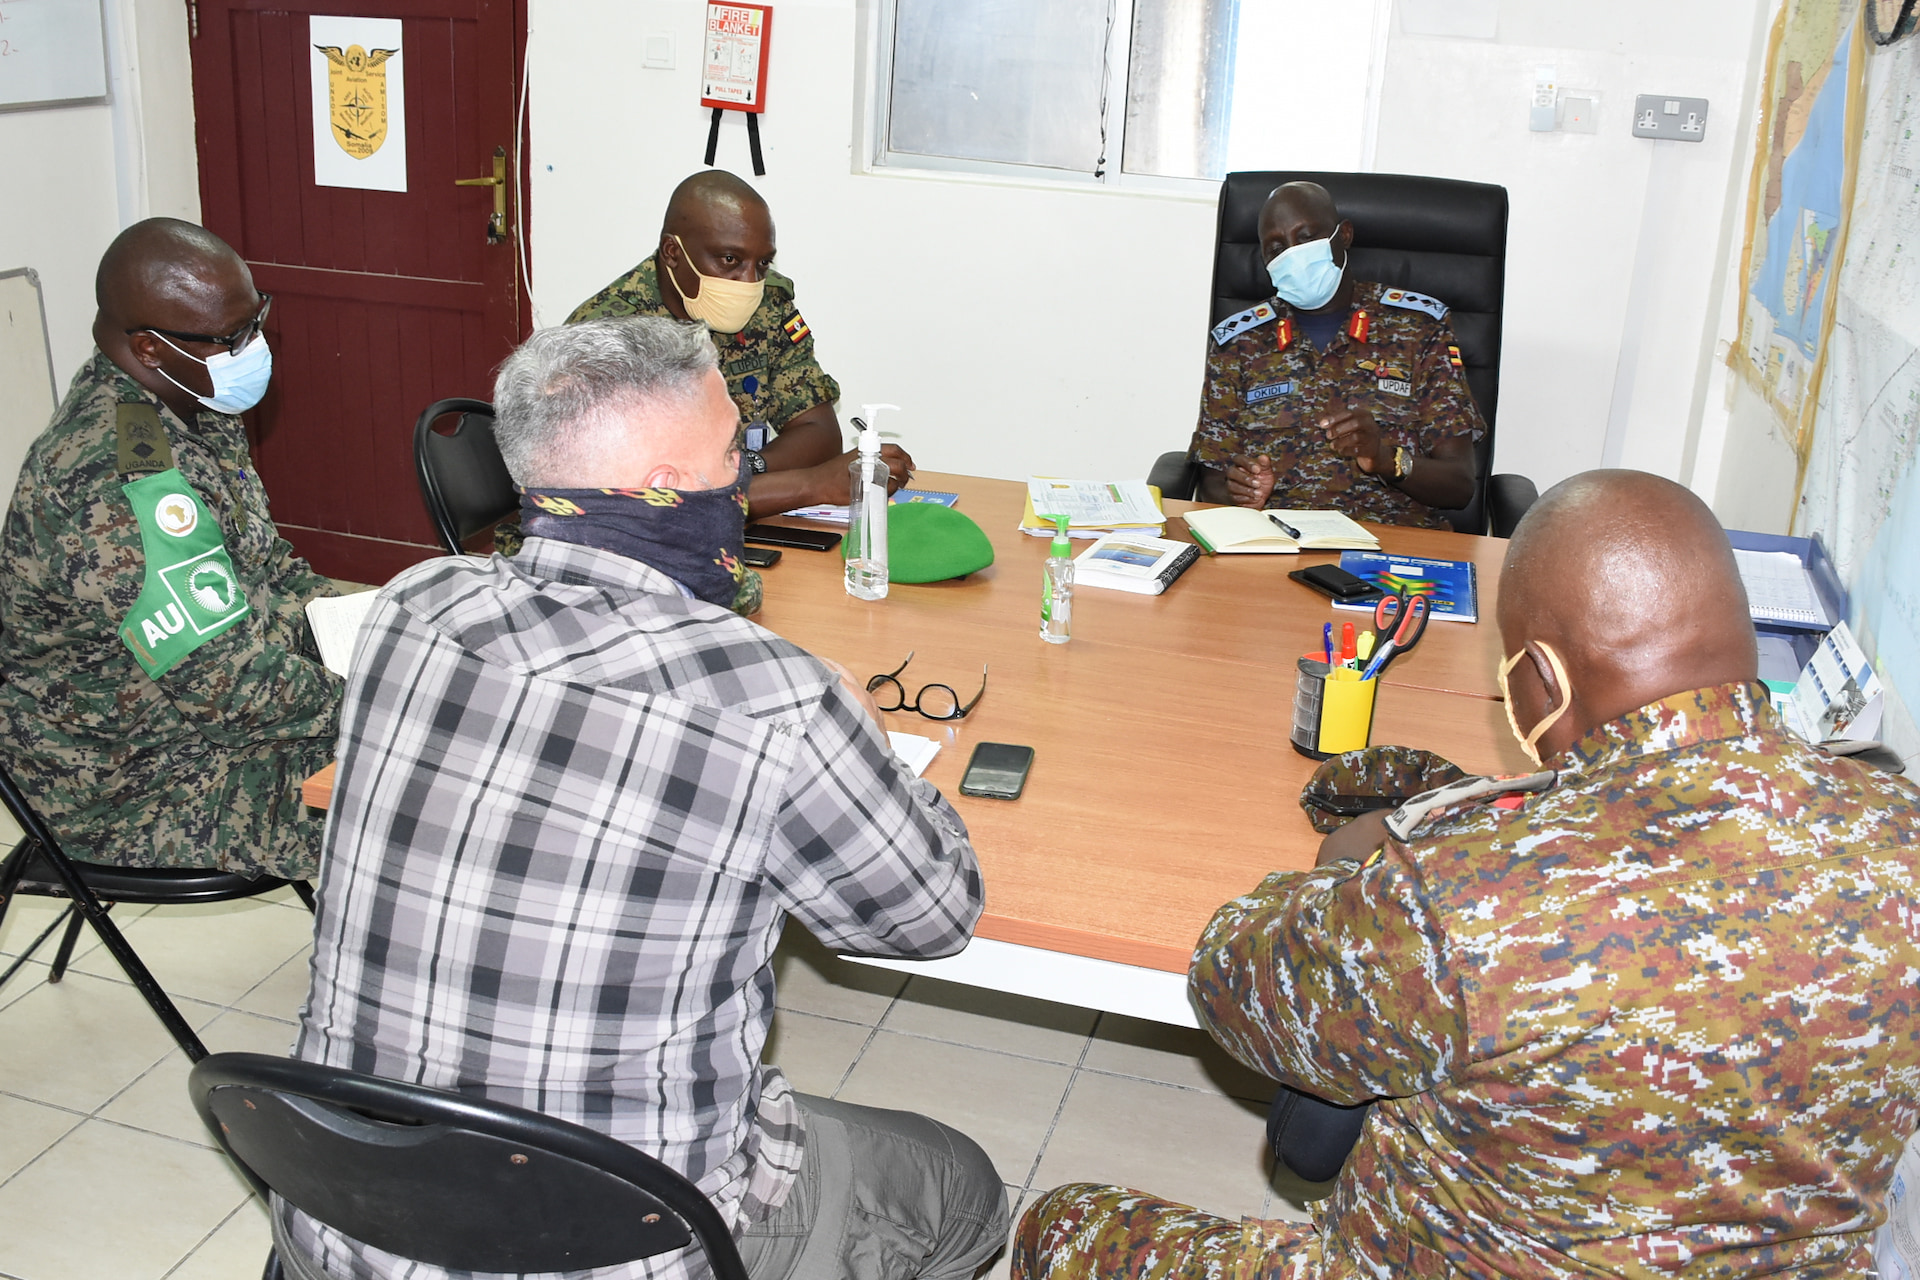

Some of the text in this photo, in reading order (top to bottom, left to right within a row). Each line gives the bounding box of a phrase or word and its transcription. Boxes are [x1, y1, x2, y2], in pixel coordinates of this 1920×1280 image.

[721, 8, 749, 23] FIRE
[709, 19, 759, 36] BLANKET
[346, 140, 372, 148] Somalia
[737, 358, 764, 372] UPDF
[1254, 386, 1281, 399] OKIDI
[1382, 379, 1410, 393] UPDAF
[125, 460, 166, 470] UGANDA
[140, 602, 185, 649] AU
